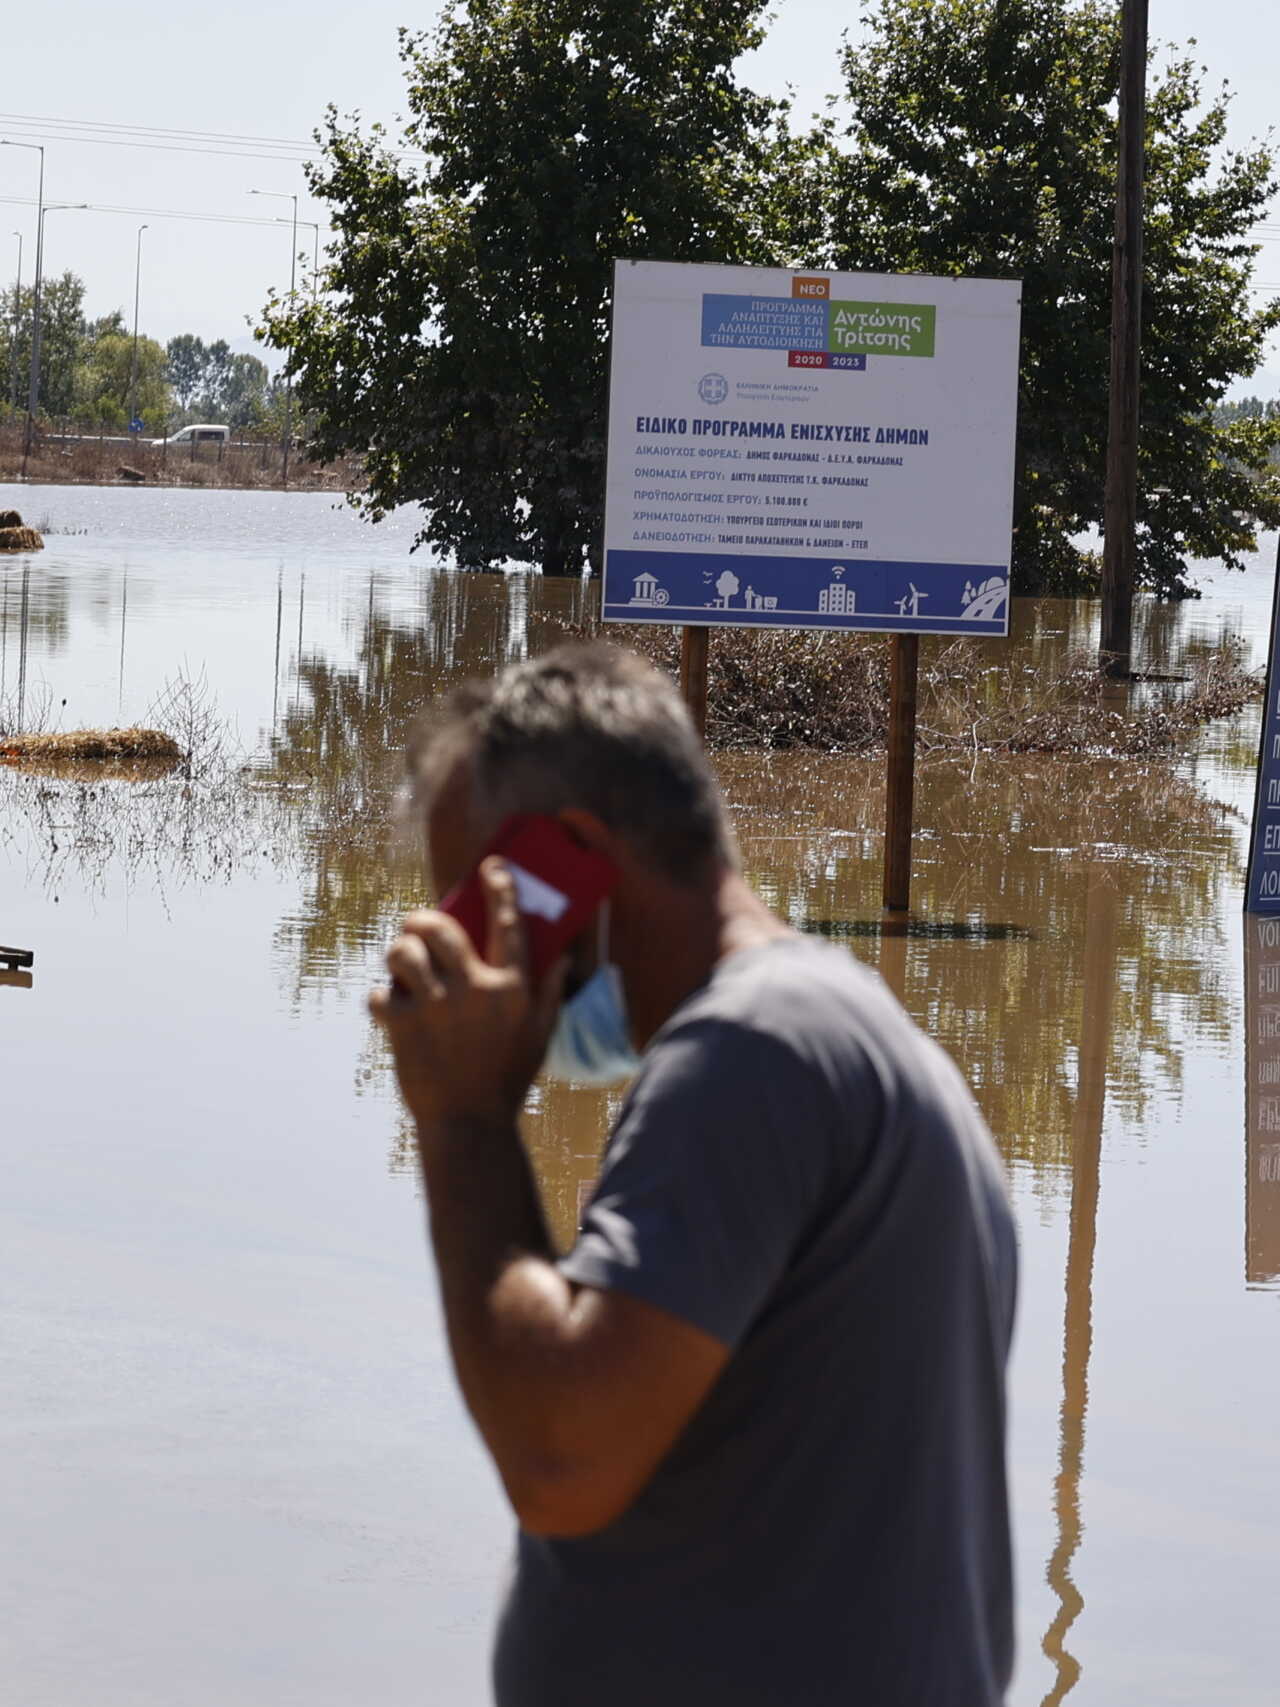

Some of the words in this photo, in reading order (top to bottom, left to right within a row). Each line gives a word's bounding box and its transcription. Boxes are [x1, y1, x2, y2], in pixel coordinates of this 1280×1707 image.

[800, 285, 825, 295] ΝΕΟ
[751, 301, 824, 314] ΠΡΟΓΡΑΜΜΑ
[731, 312, 801, 325] ΑΝΑΠΤΥΞΗΣ
[804, 316, 824, 326] ΚΑΙ
[834, 307, 922, 333] Αντώνης
[718, 323, 801, 336] ΑΛΛΗΛΕΓΓΥΗΣ
[805, 327, 823, 337] ΓΙΑ
[710, 334, 734, 344] ΤΗΝ
[738, 336, 823, 349] ΑΥΤΟΔΙΟΙΚΗΣΗ
[834, 327, 911, 351] Τρίτσης
[794, 355, 823, 366] 2020
[832, 356, 860, 367] 2023
[636, 416, 687, 434] ΕΙΔΙΚΟ
[692, 419, 785, 439] ΠΡΟΓΡΑΜΜΑ
[791, 423, 871, 443] ΕΝΙΣΧΥΣΗΣ
[875, 427, 929, 445] ΔΗΜΩΝ
[635, 446, 695, 457] ΔΙΚΑΙΟΥΧΟΣ
[698, 447, 742, 459] ΦΟΡΕΑΣ:
[634, 468, 687, 479] ΟΝΟΜΑΣΙΑ
[690, 470, 725, 480] ΕΡΓΟΥ:
[727, 495, 761, 505] ΕΡΓΟΥ:
[633, 511, 724, 524] ΧΡΗΜΑΤΟΔΟΤΗΣΗ:
[809, 519, 821, 528] ΚΑΙ
[633, 531, 714, 543] ΔΑΝΕΙΟΔΟΤΗΣΗ:
